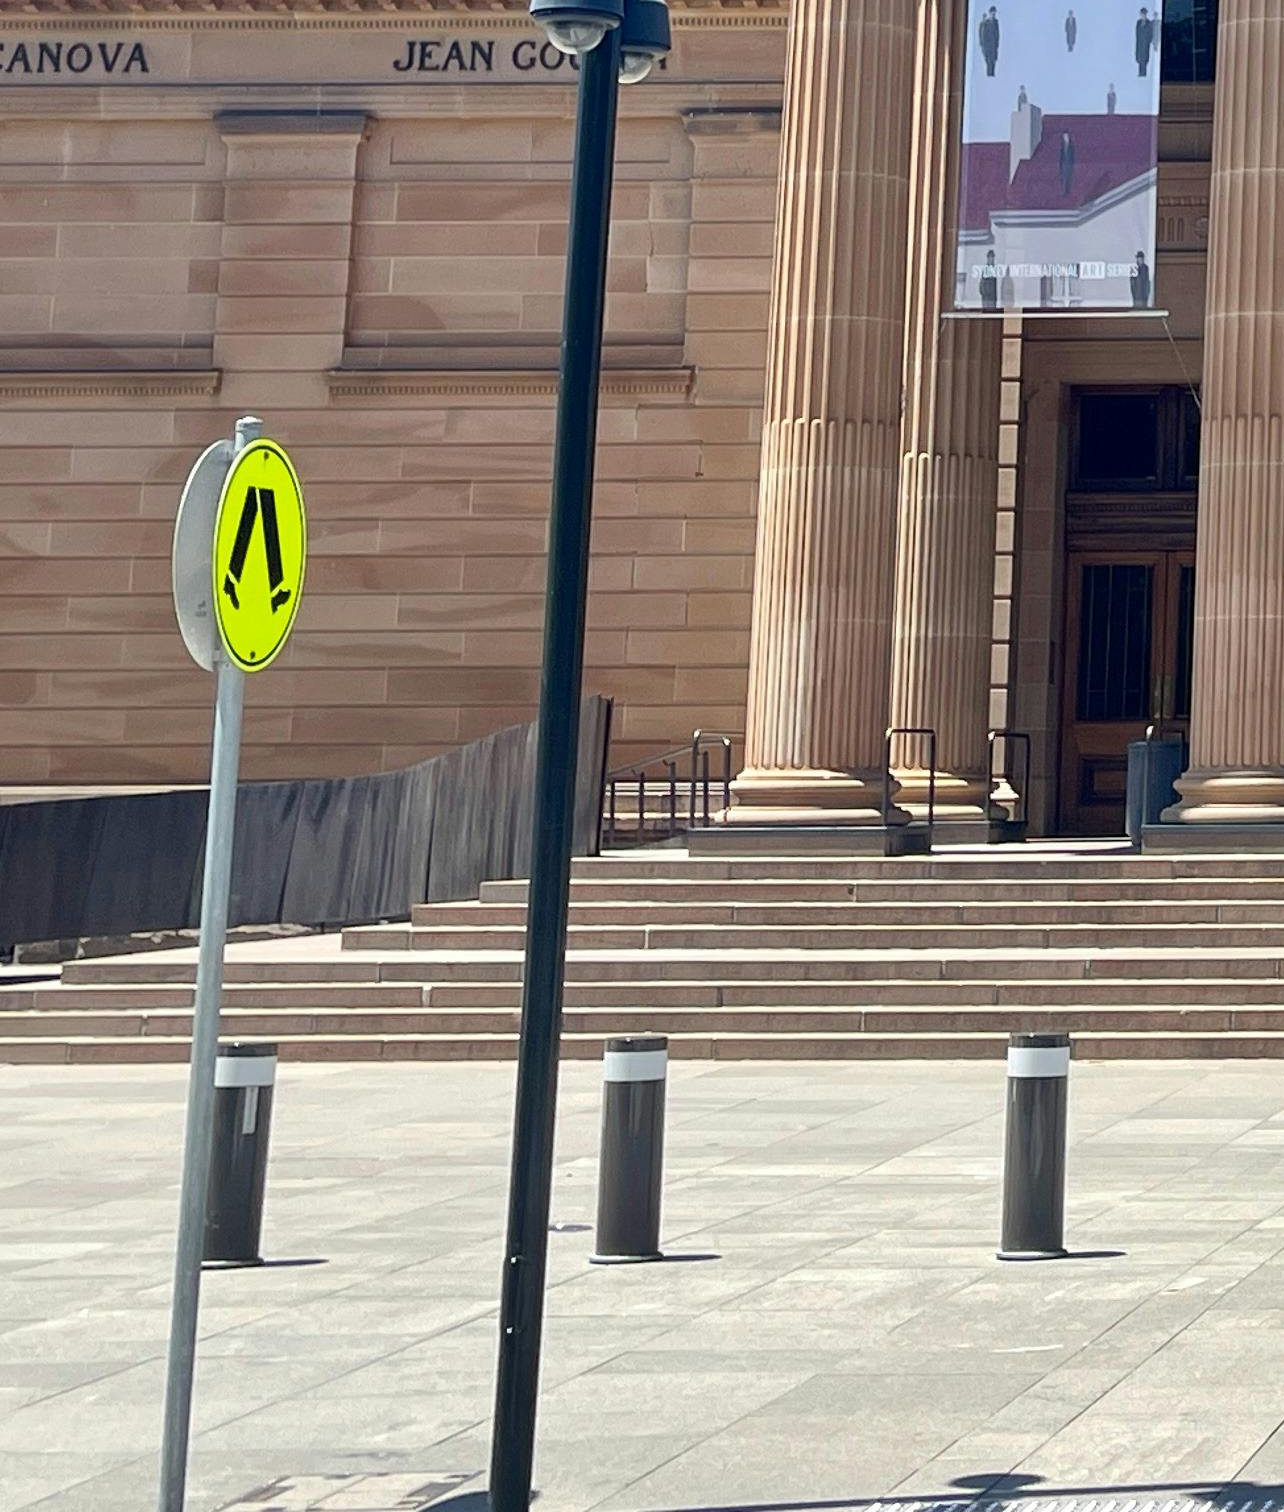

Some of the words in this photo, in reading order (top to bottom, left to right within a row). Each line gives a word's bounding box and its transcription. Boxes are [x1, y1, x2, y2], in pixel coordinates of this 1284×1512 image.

[0, 42, 150, 73] ANOVA
[392, 40, 496, 72] JEAN
[971, 263, 1007, 278] SYDNEY
[1009, 262, 1079, 278] INTERNATIONAL
[1082, 262, 1104, 278] ART
[1106, 262, 1139, 278] SERIES
